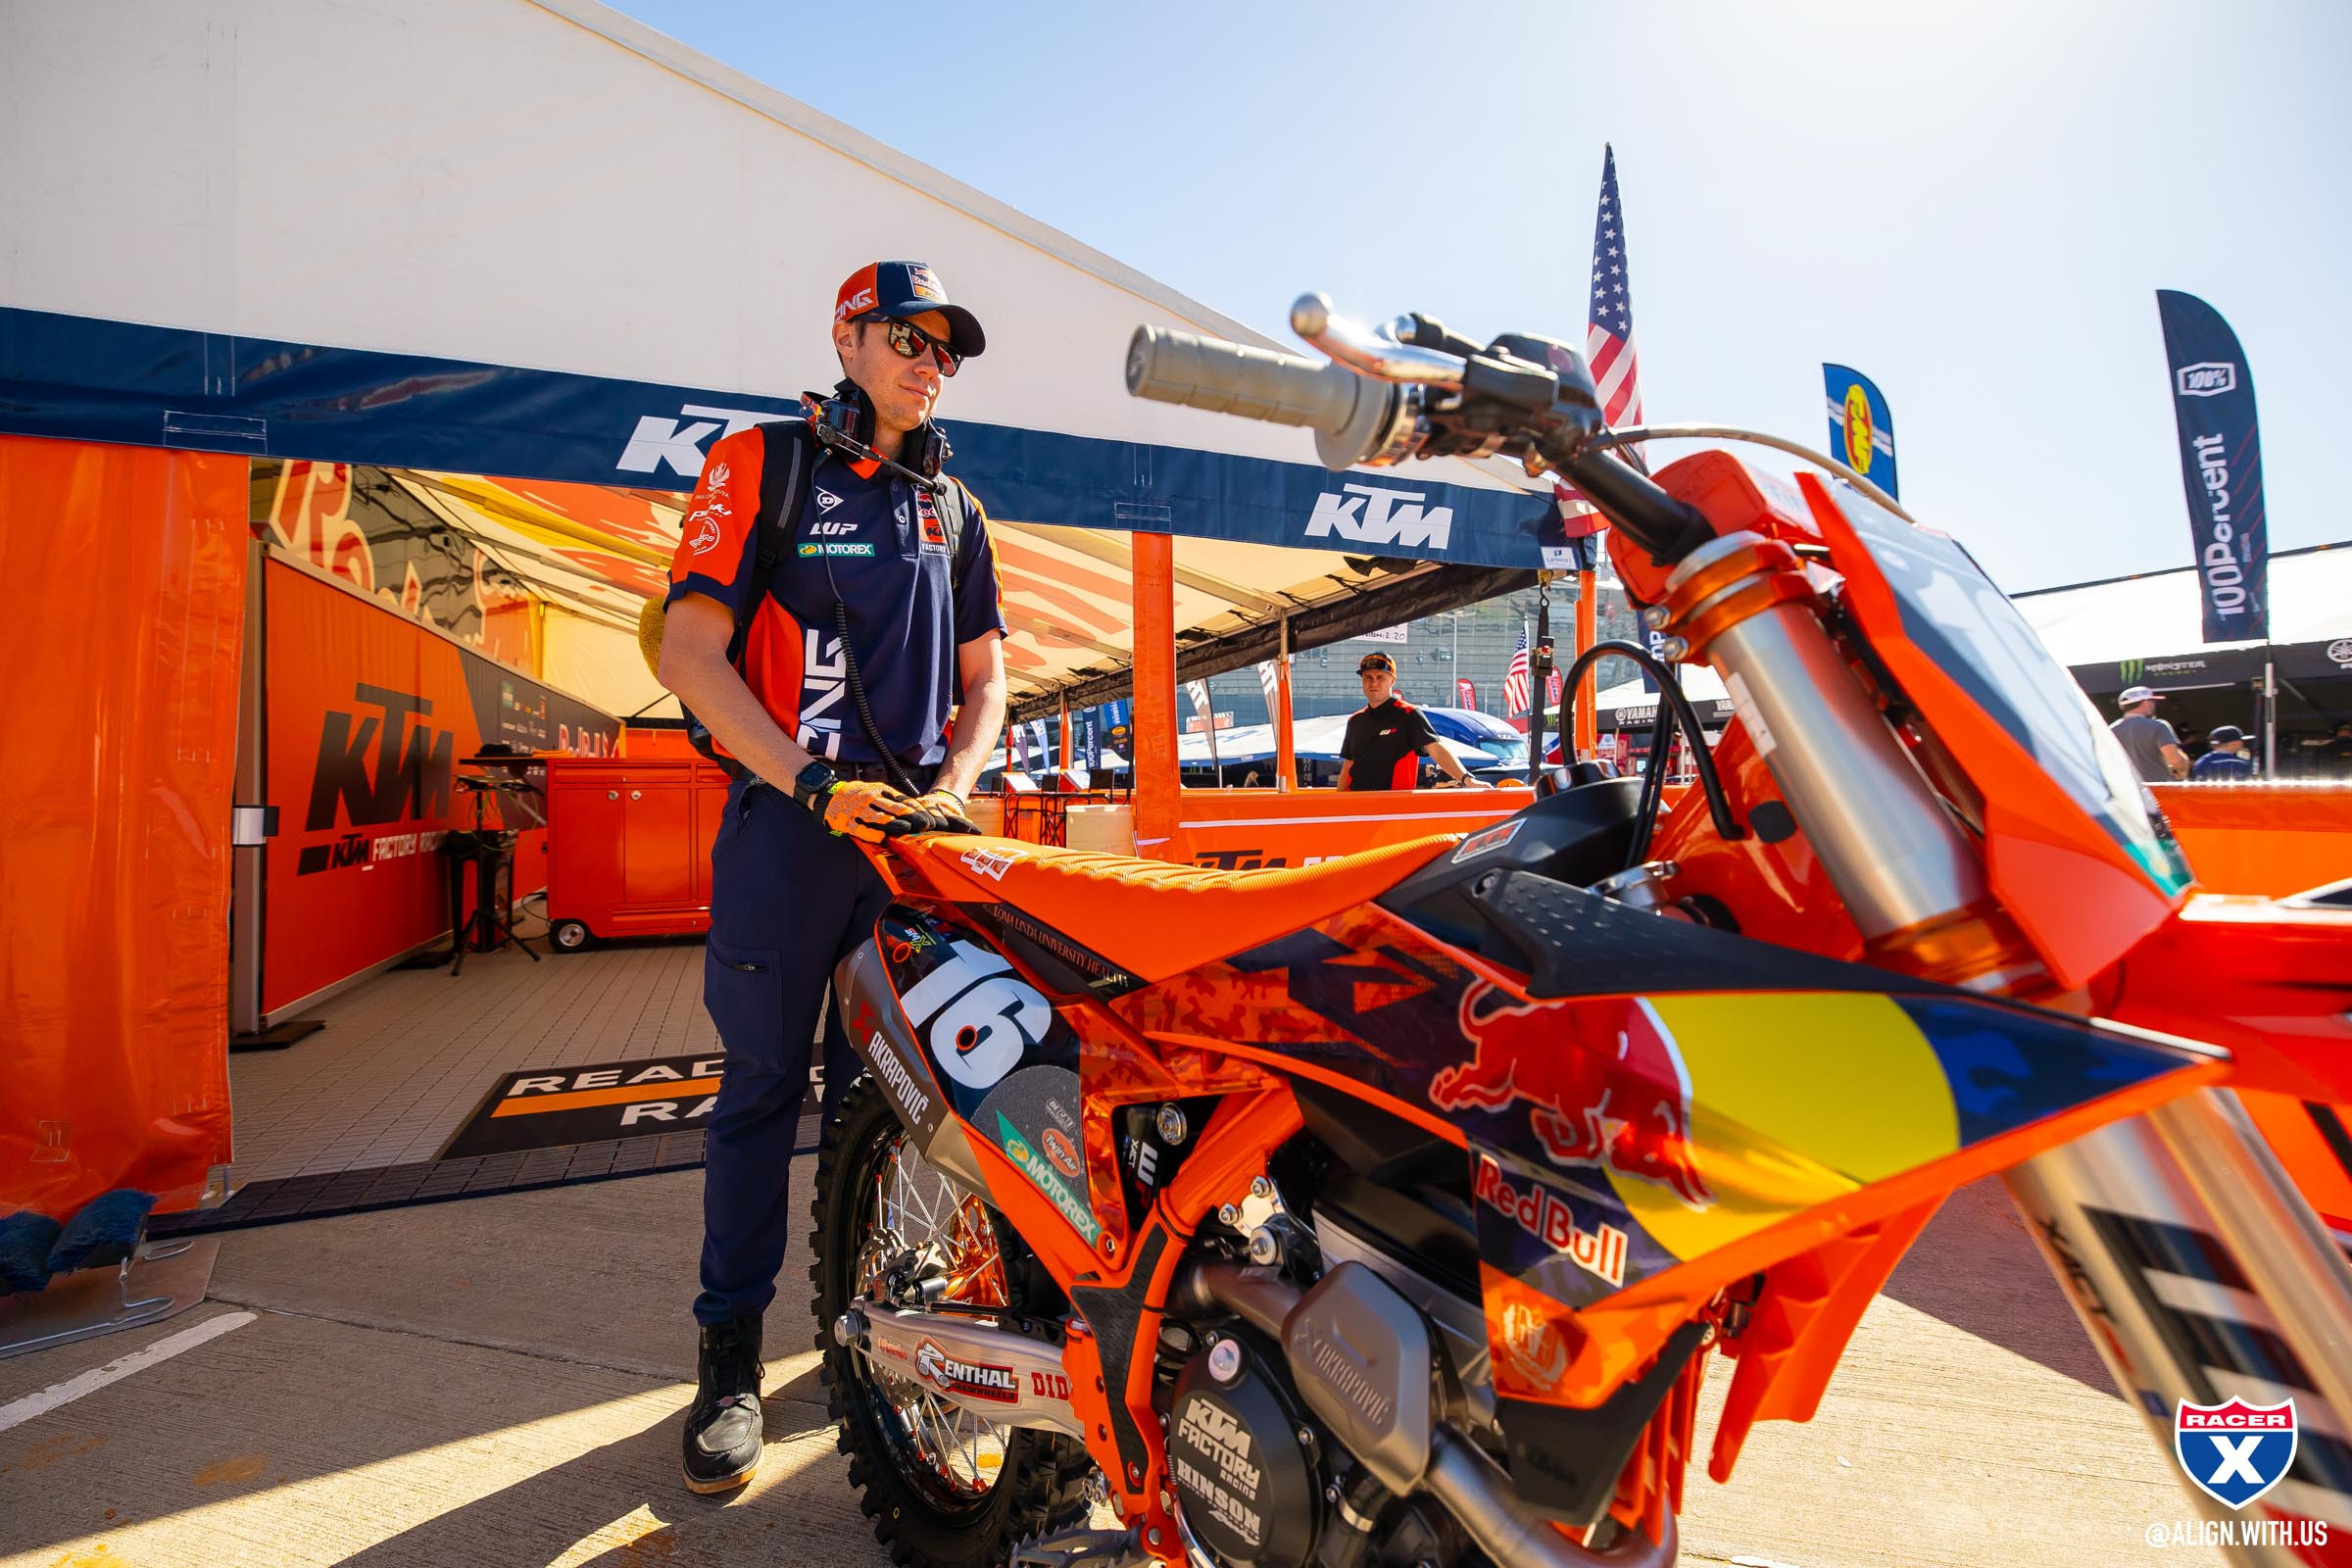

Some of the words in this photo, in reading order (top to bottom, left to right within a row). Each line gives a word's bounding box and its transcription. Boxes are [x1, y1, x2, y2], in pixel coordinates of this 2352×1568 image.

[1304, 483, 1453, 550] KTM
[2192, 433, 2247, 621] 100Percent
[817, 544, 872, 555] MOTOREX
[1086, 720, 1095, 767] 100Percent
[1627, 706, 1657, 720] YAMAH
[305, 682, 454, 831] KTM
[331, 833, 370, 869] KTM
[372, 834, 416, 861] FACTORY
[994, 905, 1014, 926] LOMA
[1014, 916, 1038, 943] LINDA
[1038, 931, 1088, 970] UNIVERSITY
[900, 940, 1052, 1089] 16
[1045, 1134, 1065, 1160] Twin
[1064, 1156, 1078, 1171] Air
[1128, 1138, 1140, 1168] XACT
[1027, 1156, 1097, 1244] MOTOREX
[1476, 1153, 1544, 1236] Red
[1543, 1196, 1627, 1287] Bull
[1178, 1418, 1260, 1490] FACTORY
[1186, 1398, 1251, 1459] KTM
[1177, 1458, 1260, 1534] HINSON
[1220, 1470, 1256, 1500] RACING
